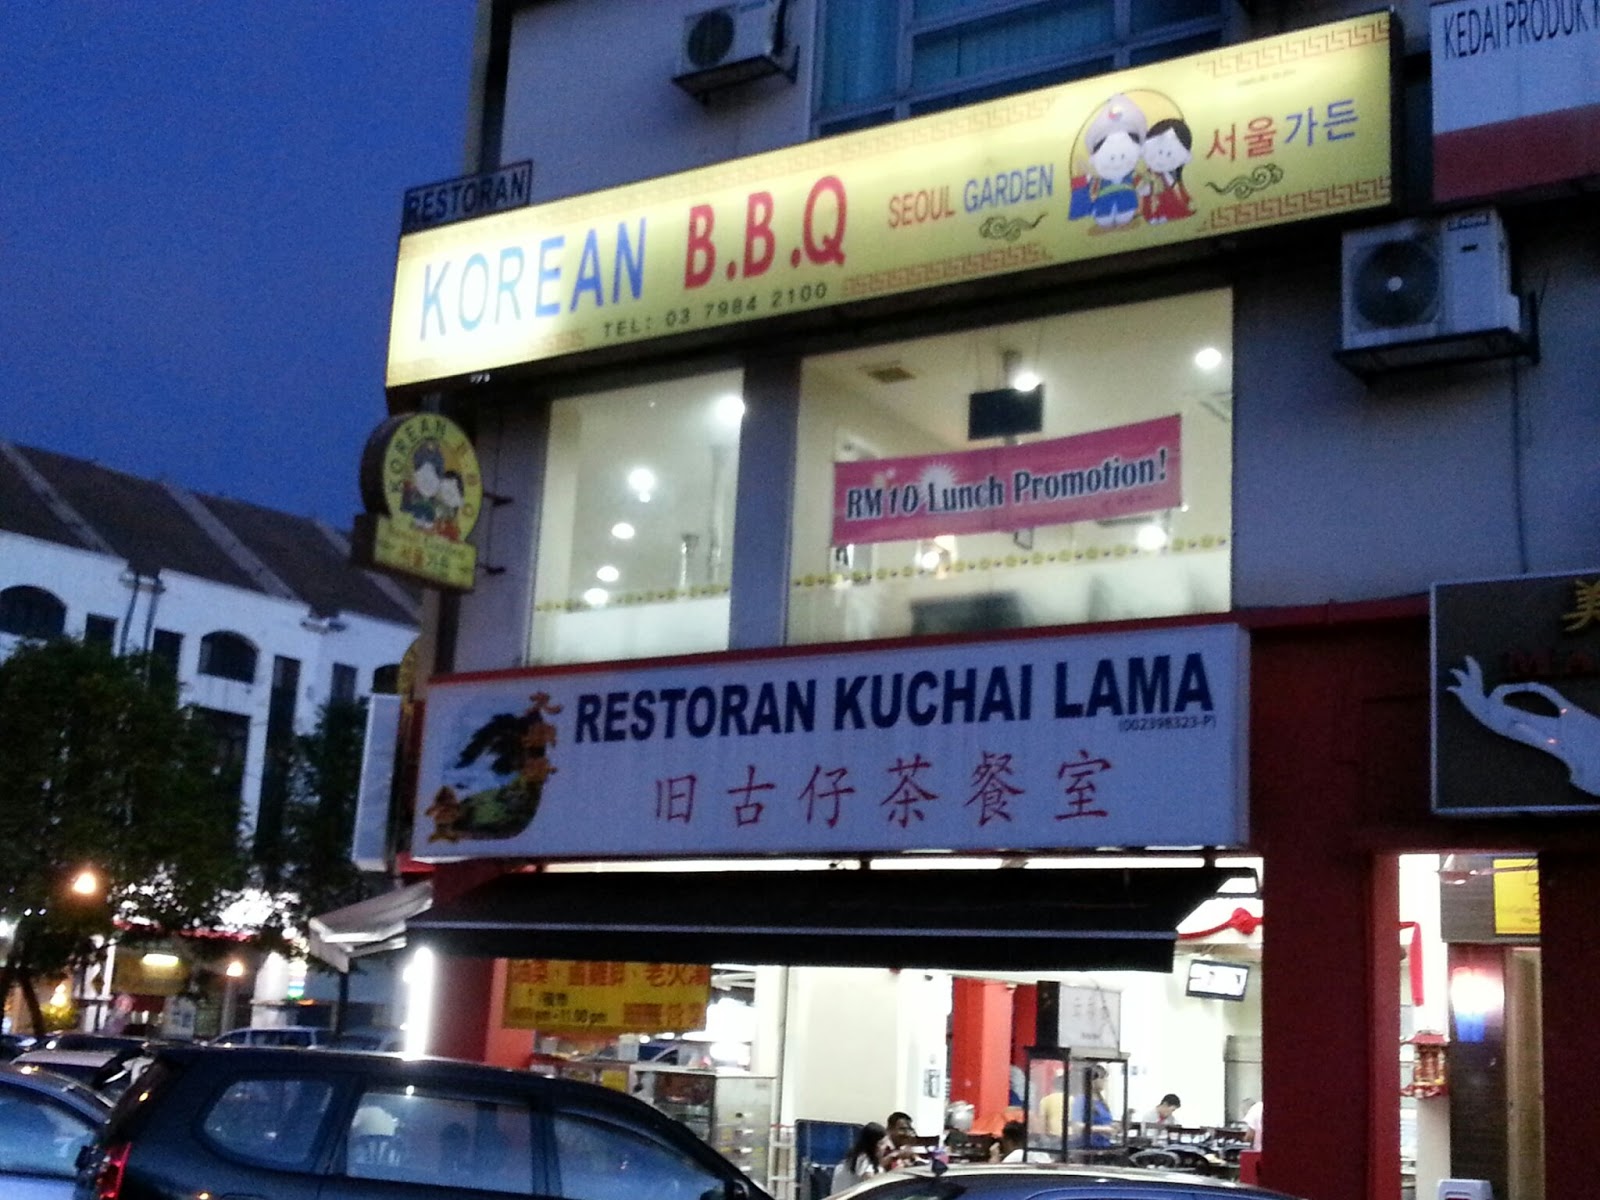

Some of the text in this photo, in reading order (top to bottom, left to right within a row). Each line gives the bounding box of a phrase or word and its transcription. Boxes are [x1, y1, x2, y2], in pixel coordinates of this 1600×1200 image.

[1443, 3, 1500, 60] KEDAI
[1504, 0, 1589, 48] PRODUK
[404, 168, 526, 222] RESTORAN
[887, 163, 1054, 230] SEOUL GARDEN
[419, 174, 848, 341] KOREAN B.B.Q
[603, 281, 829, 338] TEL: 03 7984 2100
[927, 474, 1004, 515] Lunch
[1012, 446, 1168, 504] Promotion!
[574, 652, 1215, 744] RESTORAN KUCHAI LAMA
[654, 749, 1113, 829] 旧古仔茶餐室
